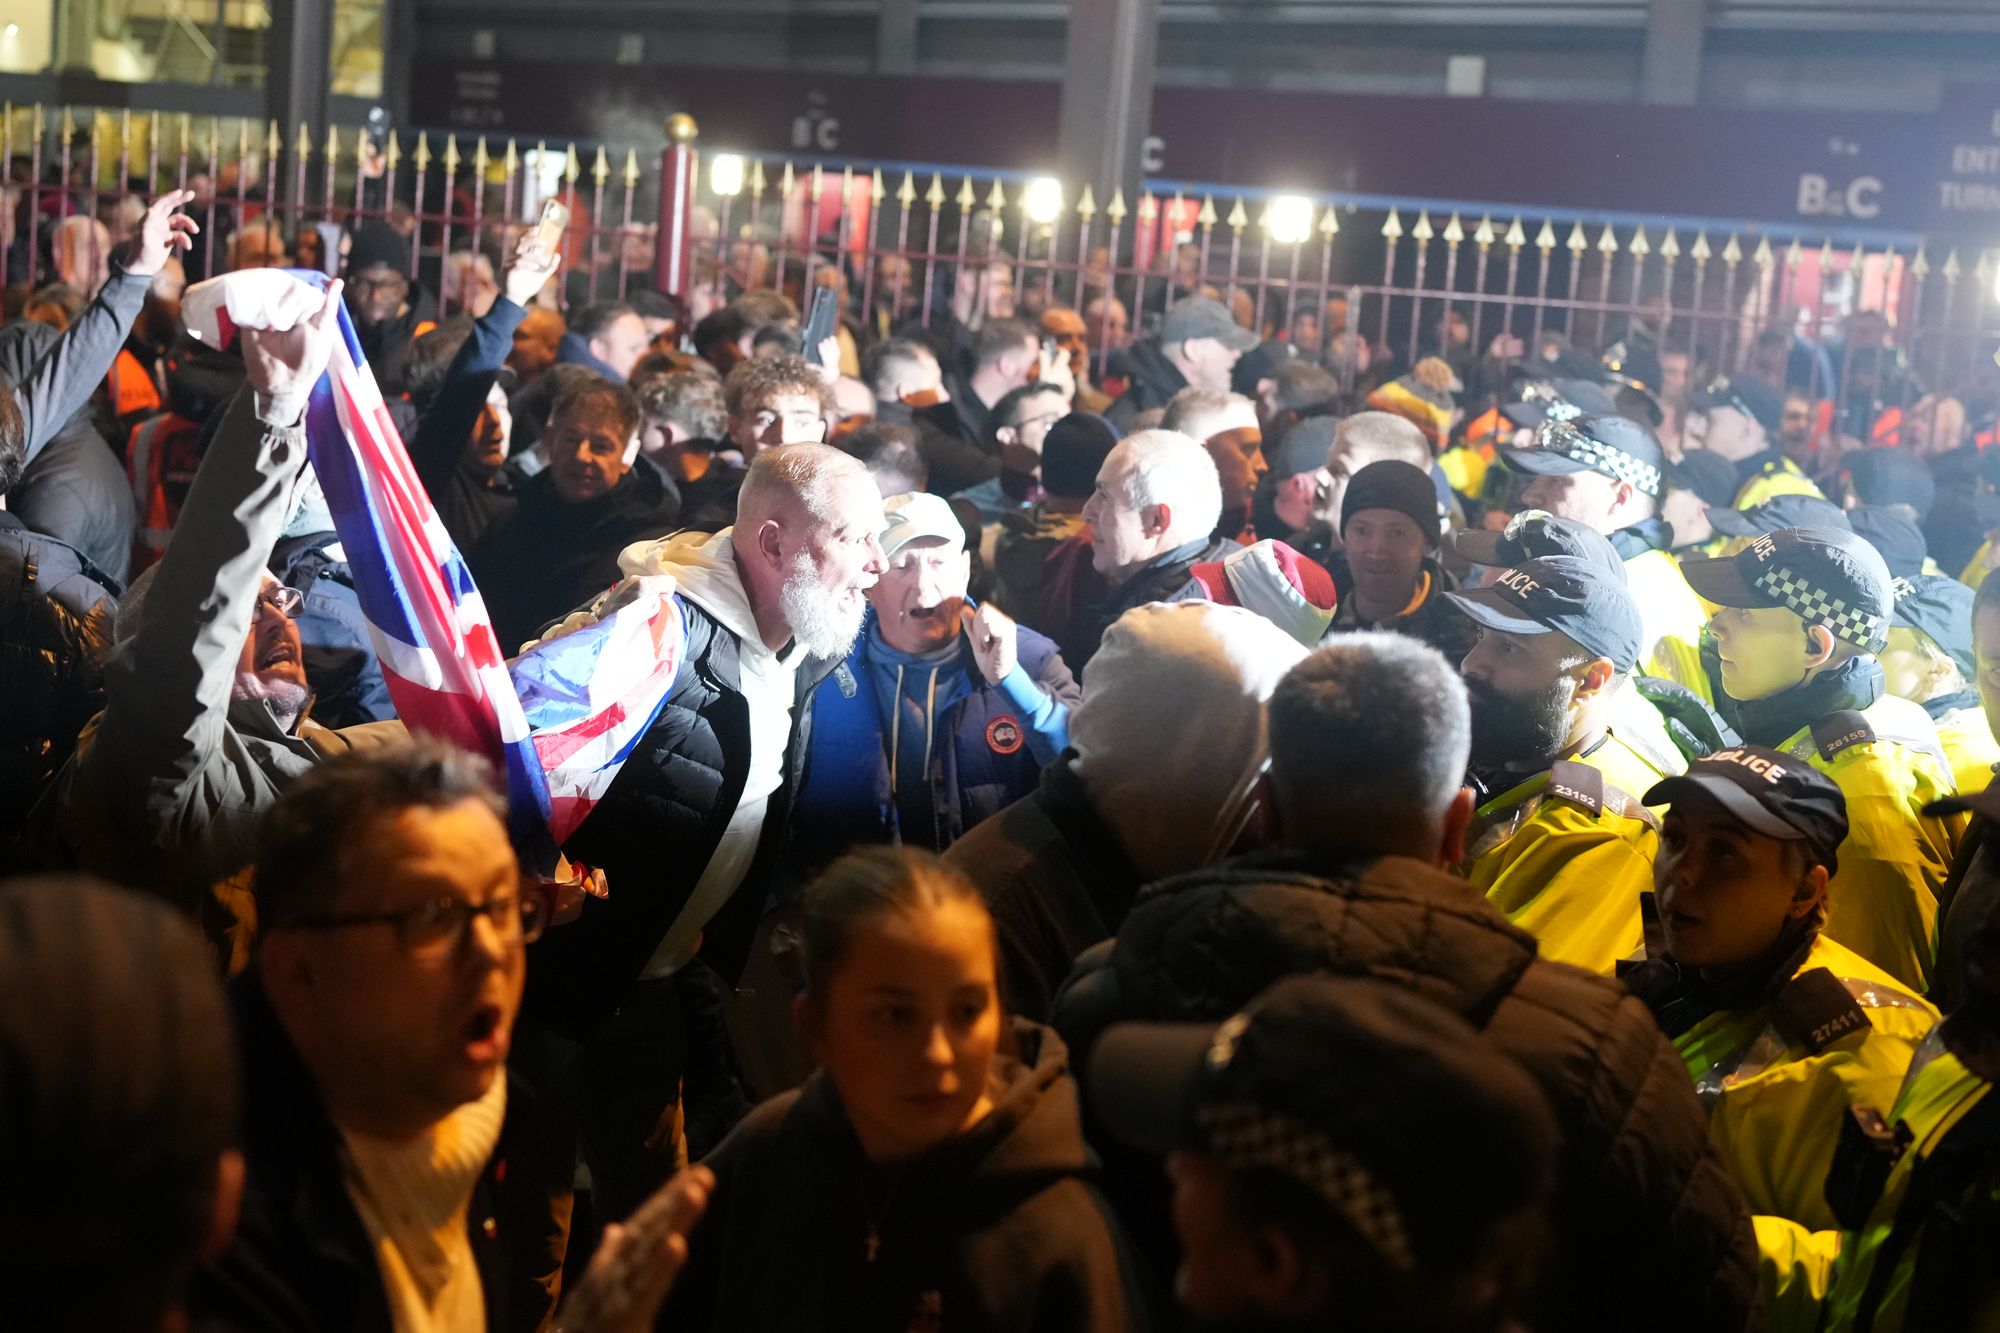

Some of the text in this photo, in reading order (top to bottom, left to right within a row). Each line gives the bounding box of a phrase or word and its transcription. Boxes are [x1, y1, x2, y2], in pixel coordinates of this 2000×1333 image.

[1826, 729, 1867, 752] 28159
[1555, 784, 1596, 807] 23152
[1812, 1010, 1859, 1043] 27411
